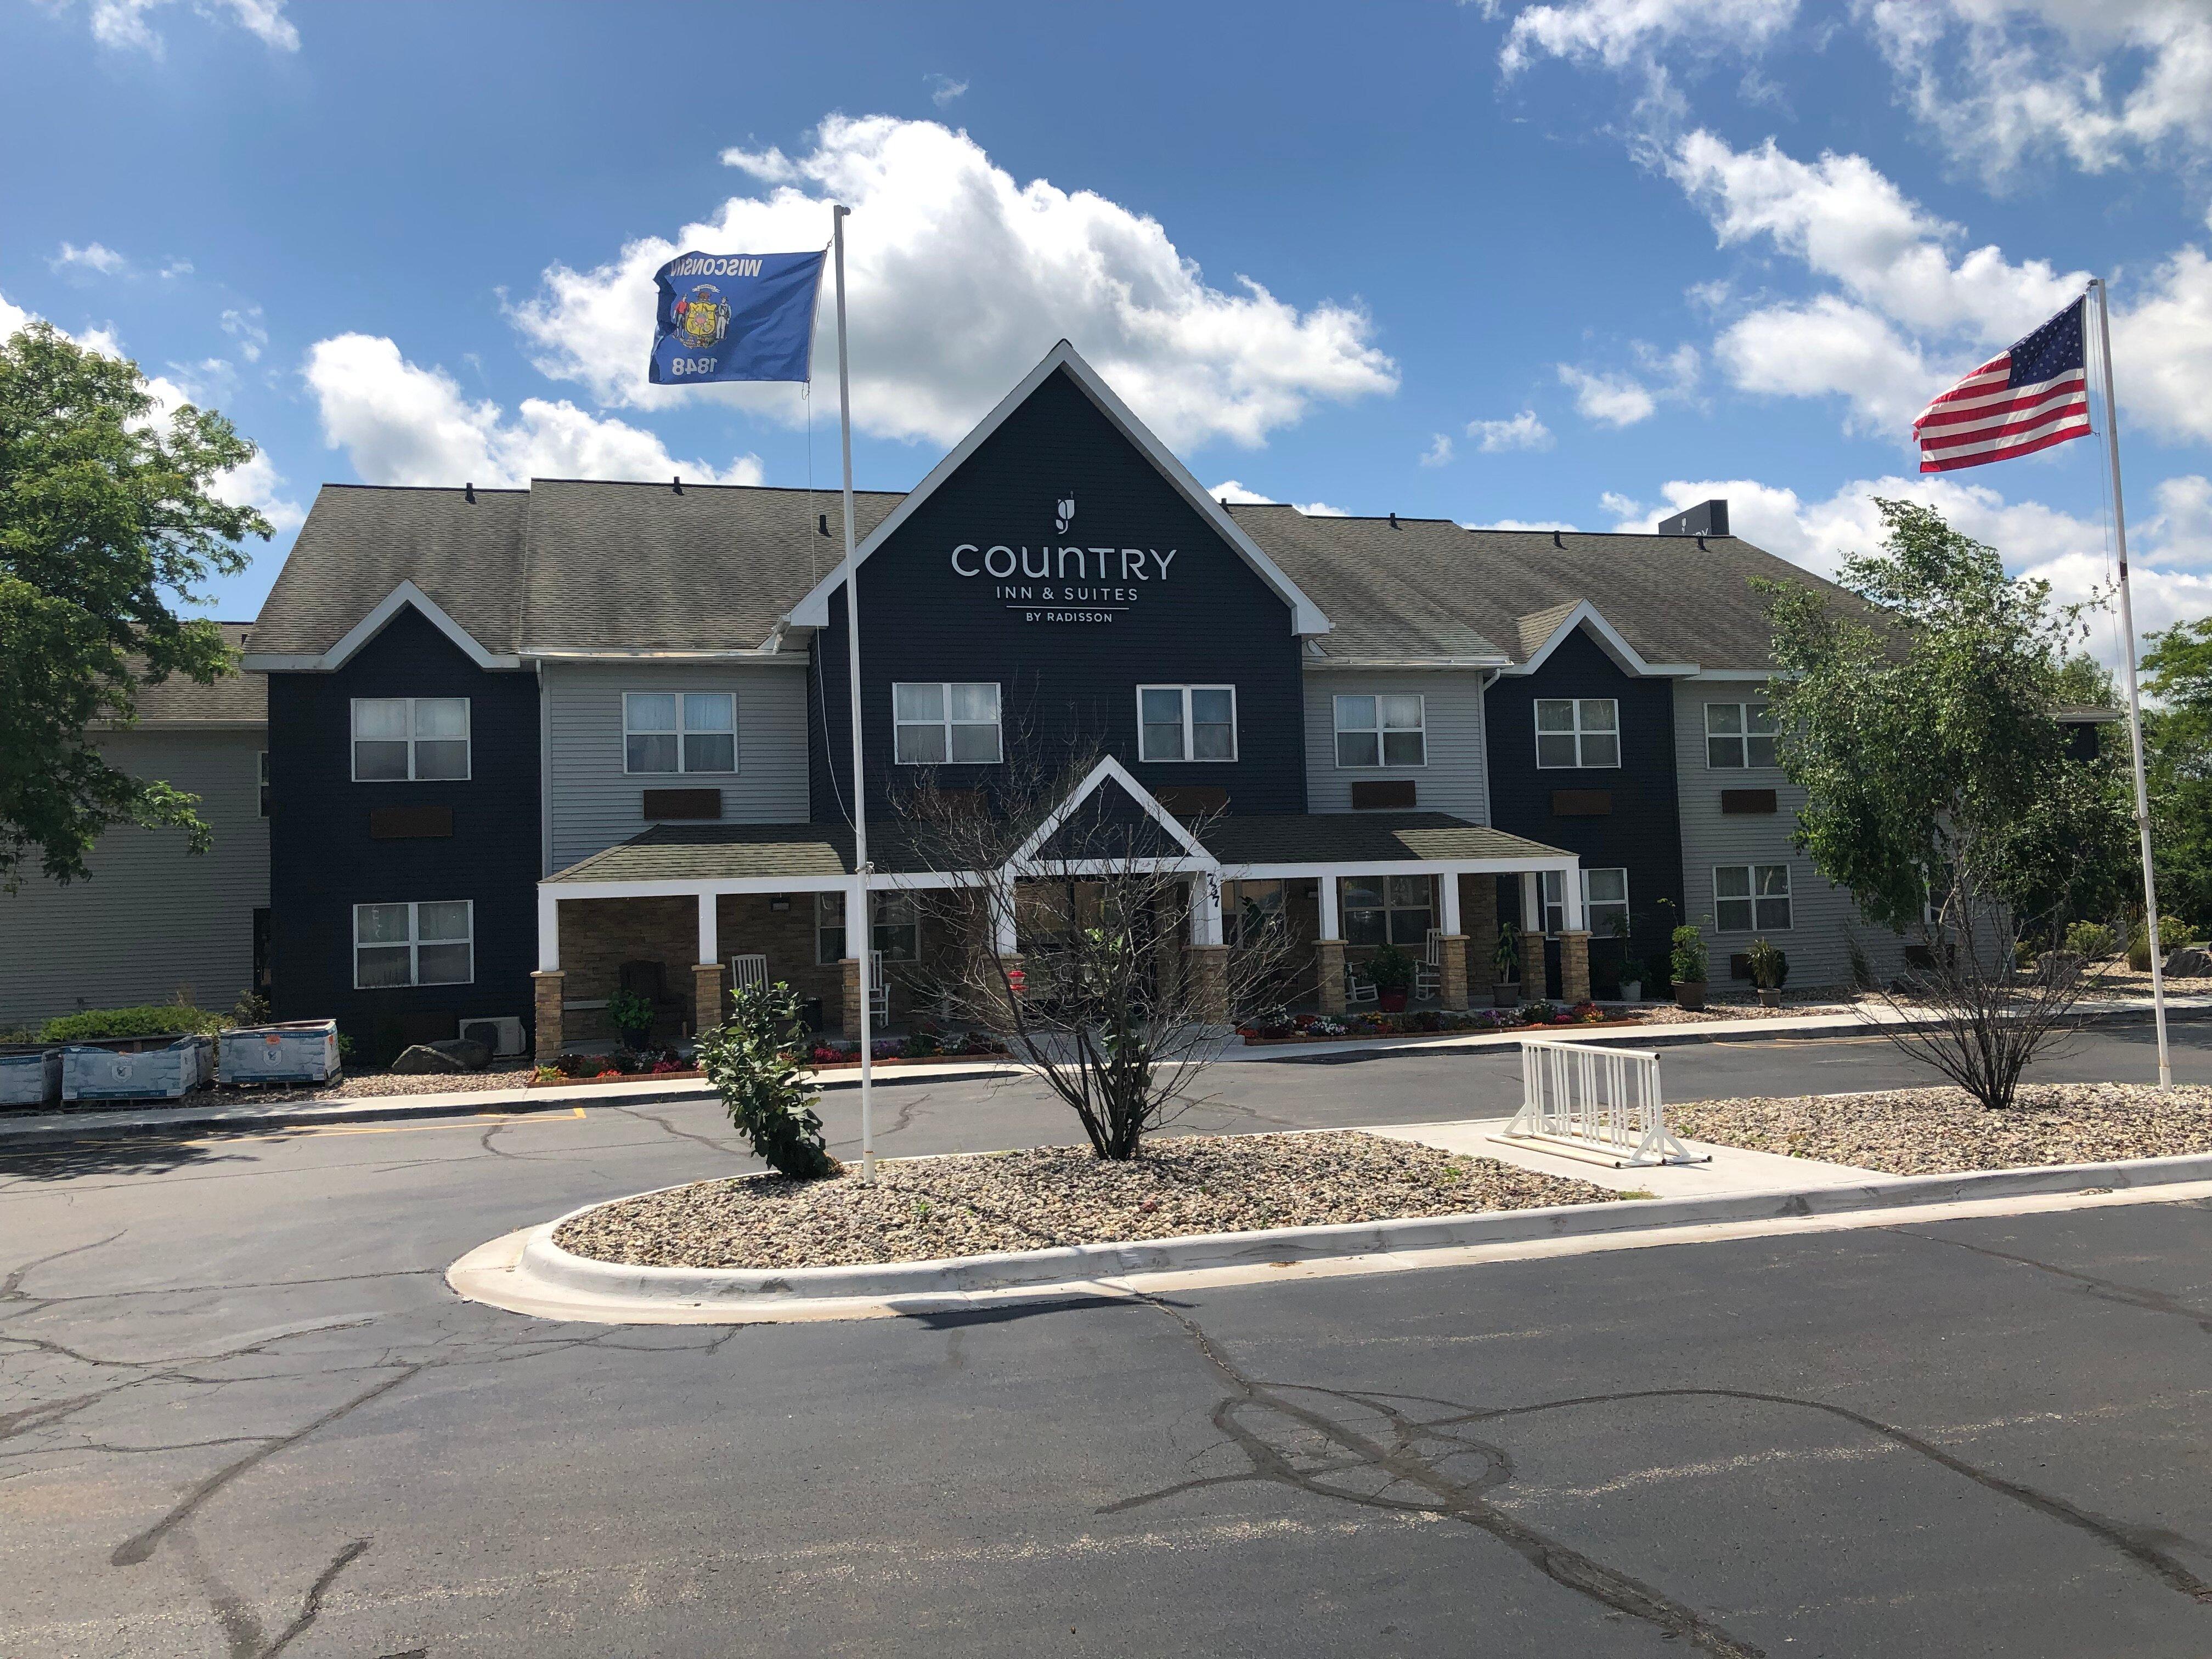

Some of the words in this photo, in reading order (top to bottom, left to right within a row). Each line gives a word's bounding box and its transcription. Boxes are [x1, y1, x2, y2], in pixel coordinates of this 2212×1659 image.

[996, 586, 1032, 599] INN
[1042, 587, 1054, 600] &
[1064, 587, 1138, 601] SUITES
[1026, 612, 1042, 622] BY
[1047, 612, 1113, 622] RADISSON
